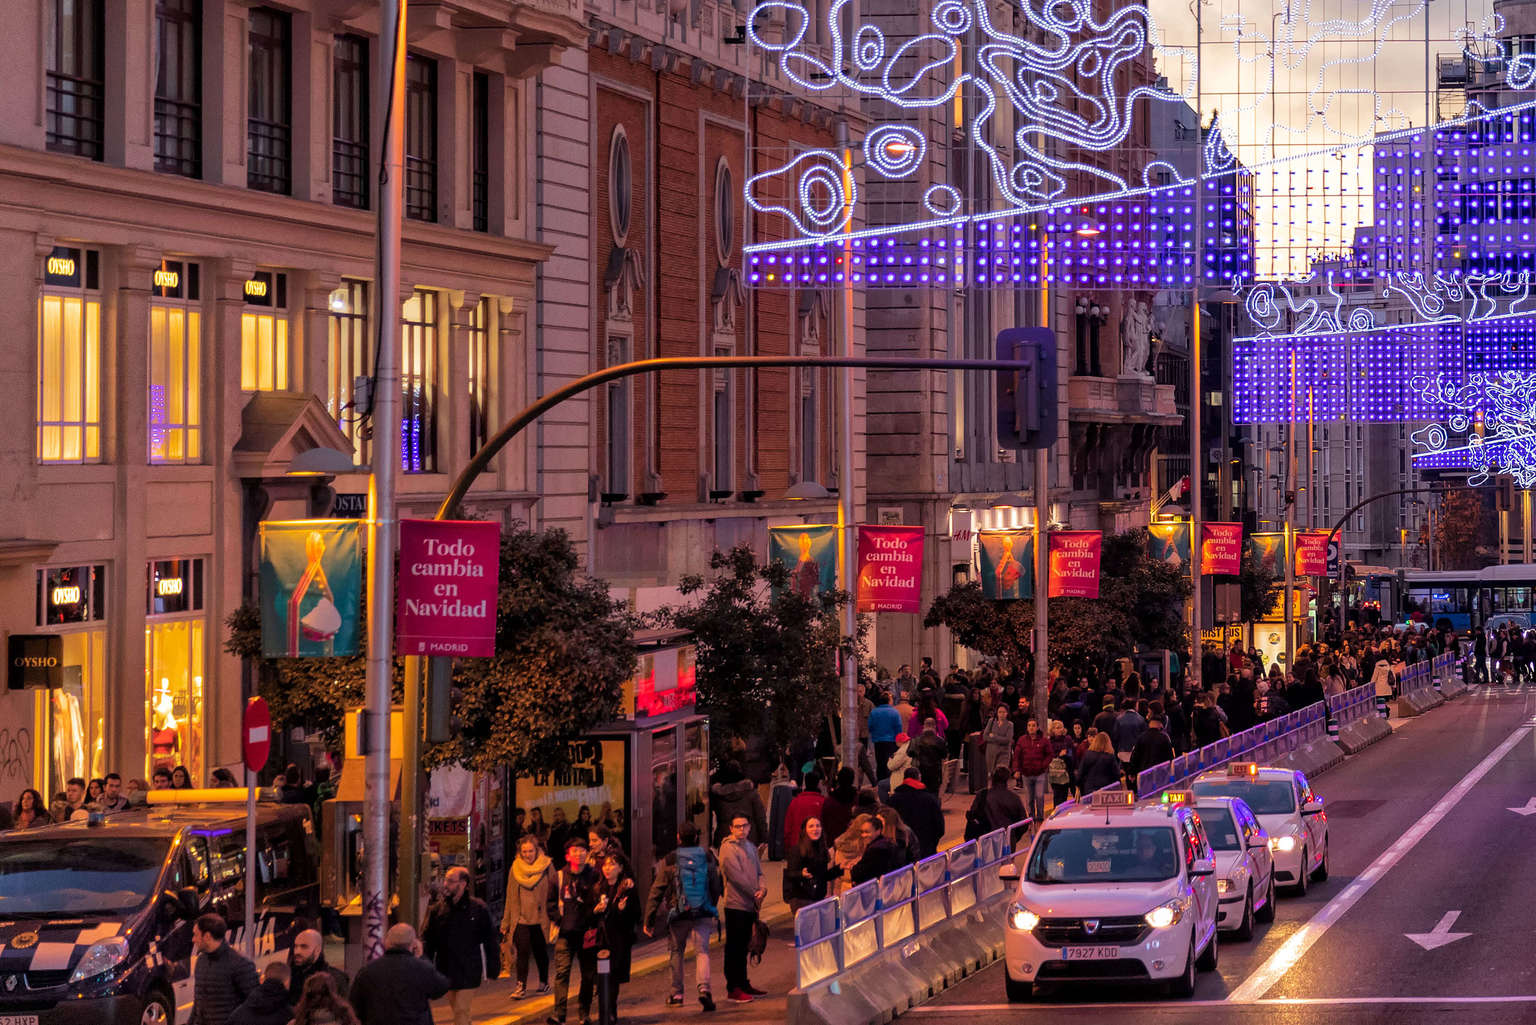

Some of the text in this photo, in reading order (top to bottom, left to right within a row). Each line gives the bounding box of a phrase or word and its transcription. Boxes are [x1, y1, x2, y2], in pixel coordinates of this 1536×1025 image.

[48, 257, 75, 276] OYSHO
[154, 271, 178, 288] OYSHO
[244, 280, 267, 297] OYSHO
[423, 538, 475, 556] Todo
[872, 537, 908, 549] Todo
[1062, 539, 1089, 548] Todo
[865, 550, 913, 563] cambia
[1056, 549, 1094, 558] cambia
[411, 559, 484, 577] cambia
[880, 565, 896, 575] en
[1068, 560, 1081, 568] en
[1052, 567, 1096, 579] Navidad
[158, 577, 183, 596] OYSHO
[862, 575, 915, 588] Navidad
[53, 585, 81, 605] OYSHO
[433, 582, 458, 597] en
[405, 598, 487, 618] Navidad
[430, 642, 469, 652] MADRID
[14, 656, 58, 668] OYSHO
[1101, 793, 1124, 804] TAXI
[1169, 793, 1184, 802] TAXI
[1068, 947, 1095, 959] 7927
